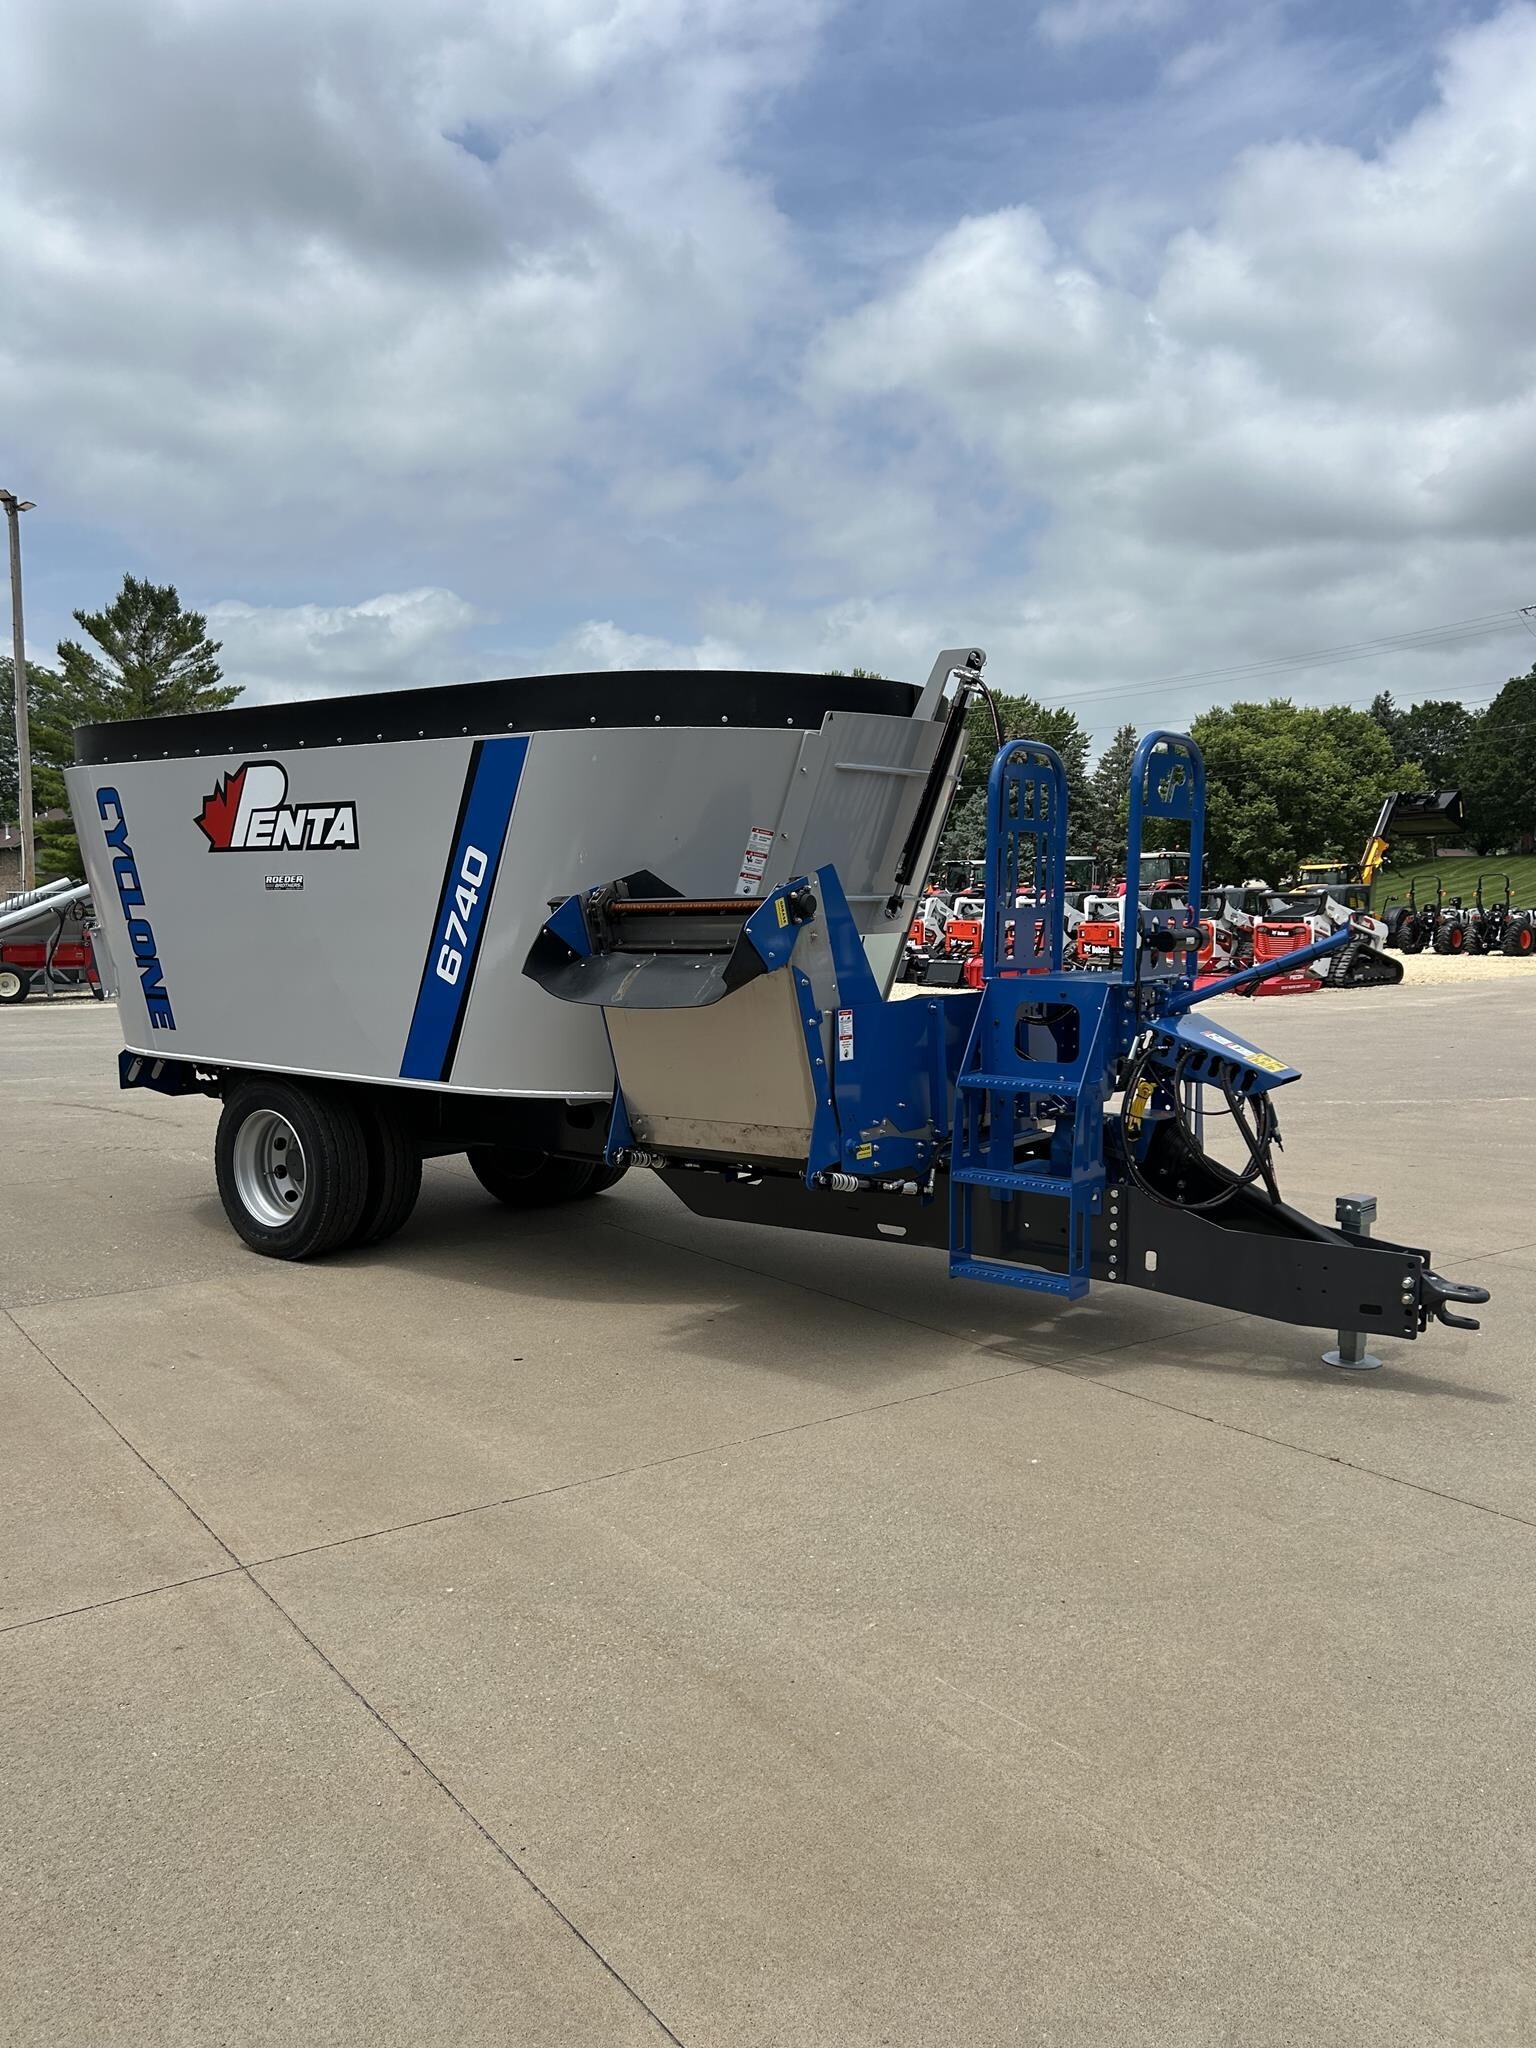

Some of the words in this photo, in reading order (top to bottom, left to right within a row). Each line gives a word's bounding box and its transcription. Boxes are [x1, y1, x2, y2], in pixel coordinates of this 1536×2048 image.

[229, 765, 356, 848] PENTA
[96, 787, 177, 1031] CYCLONE
[436, 845, 488, 986] 6740
